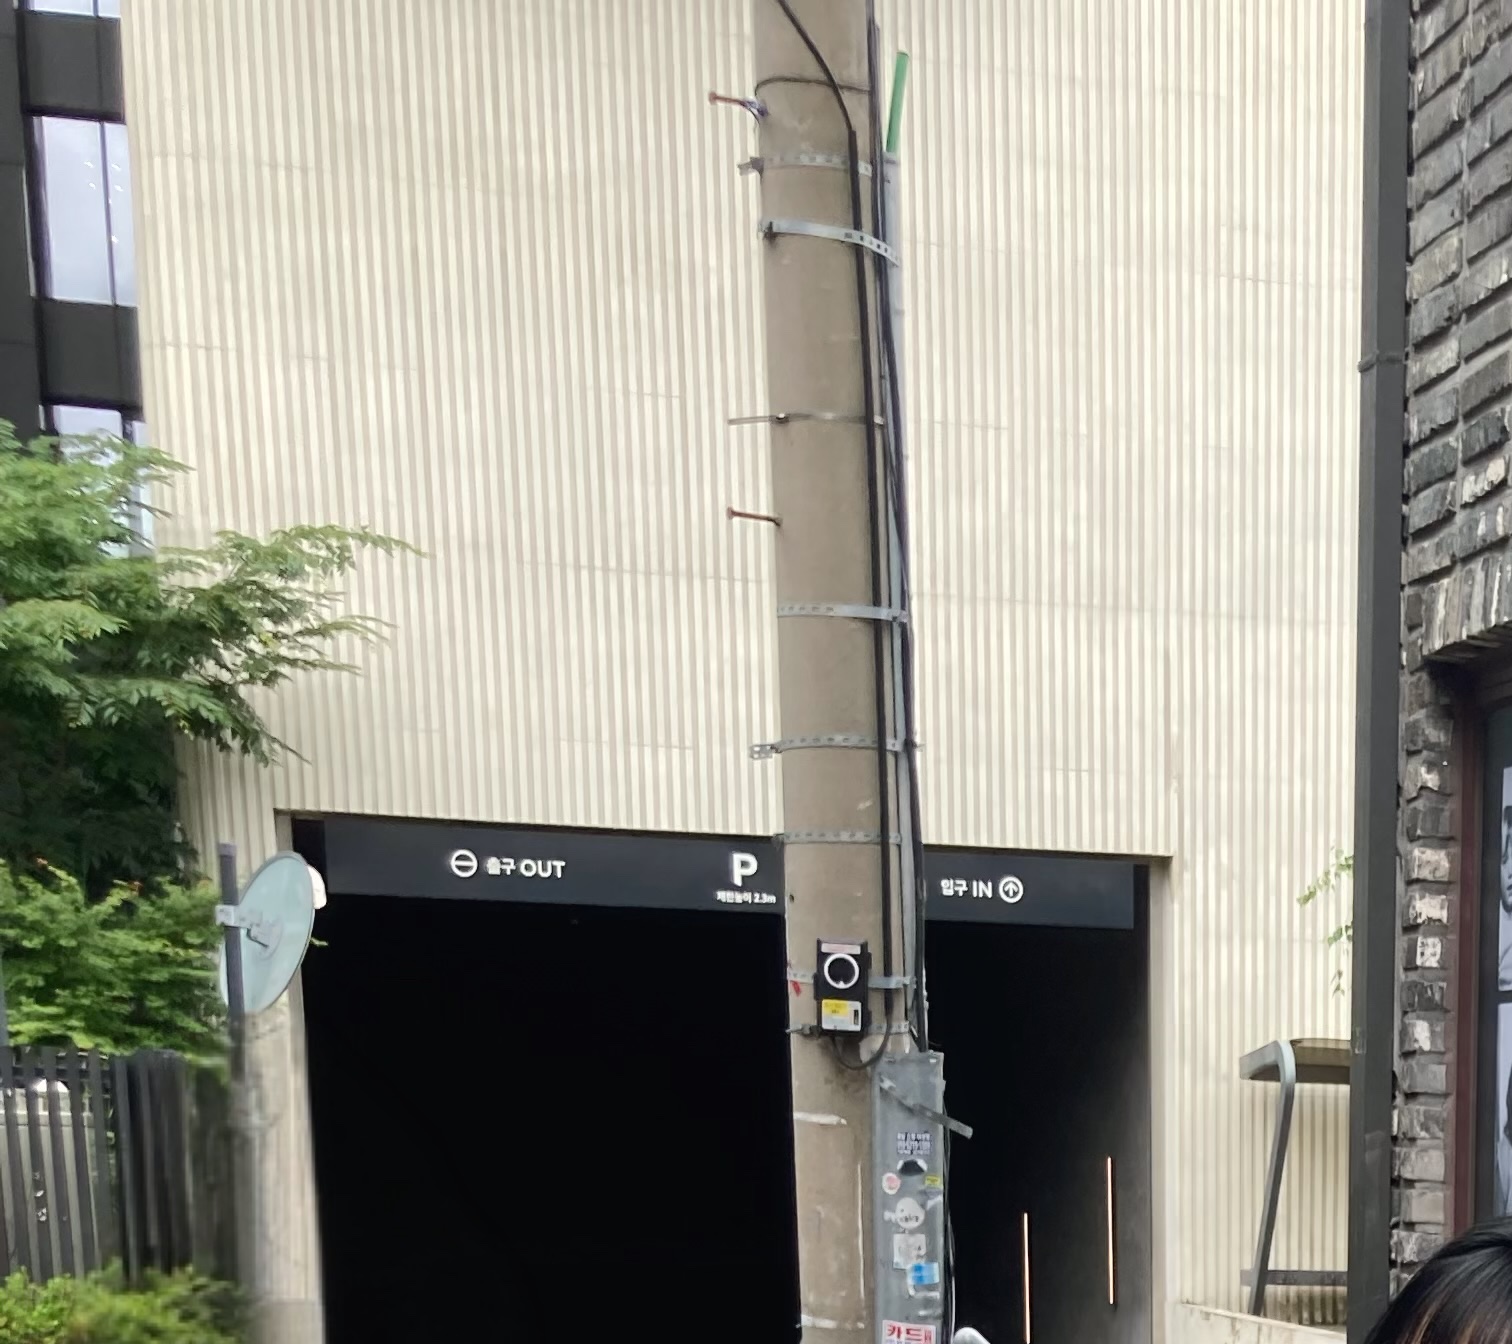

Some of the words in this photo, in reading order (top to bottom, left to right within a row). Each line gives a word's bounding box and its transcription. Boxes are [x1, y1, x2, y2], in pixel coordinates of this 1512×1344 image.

[519, 858, 566, 878] OUT
[732, 852, 758, 887] P
[940, 878, 968, 897] 입구
[972, 880, 993, 898] IN
